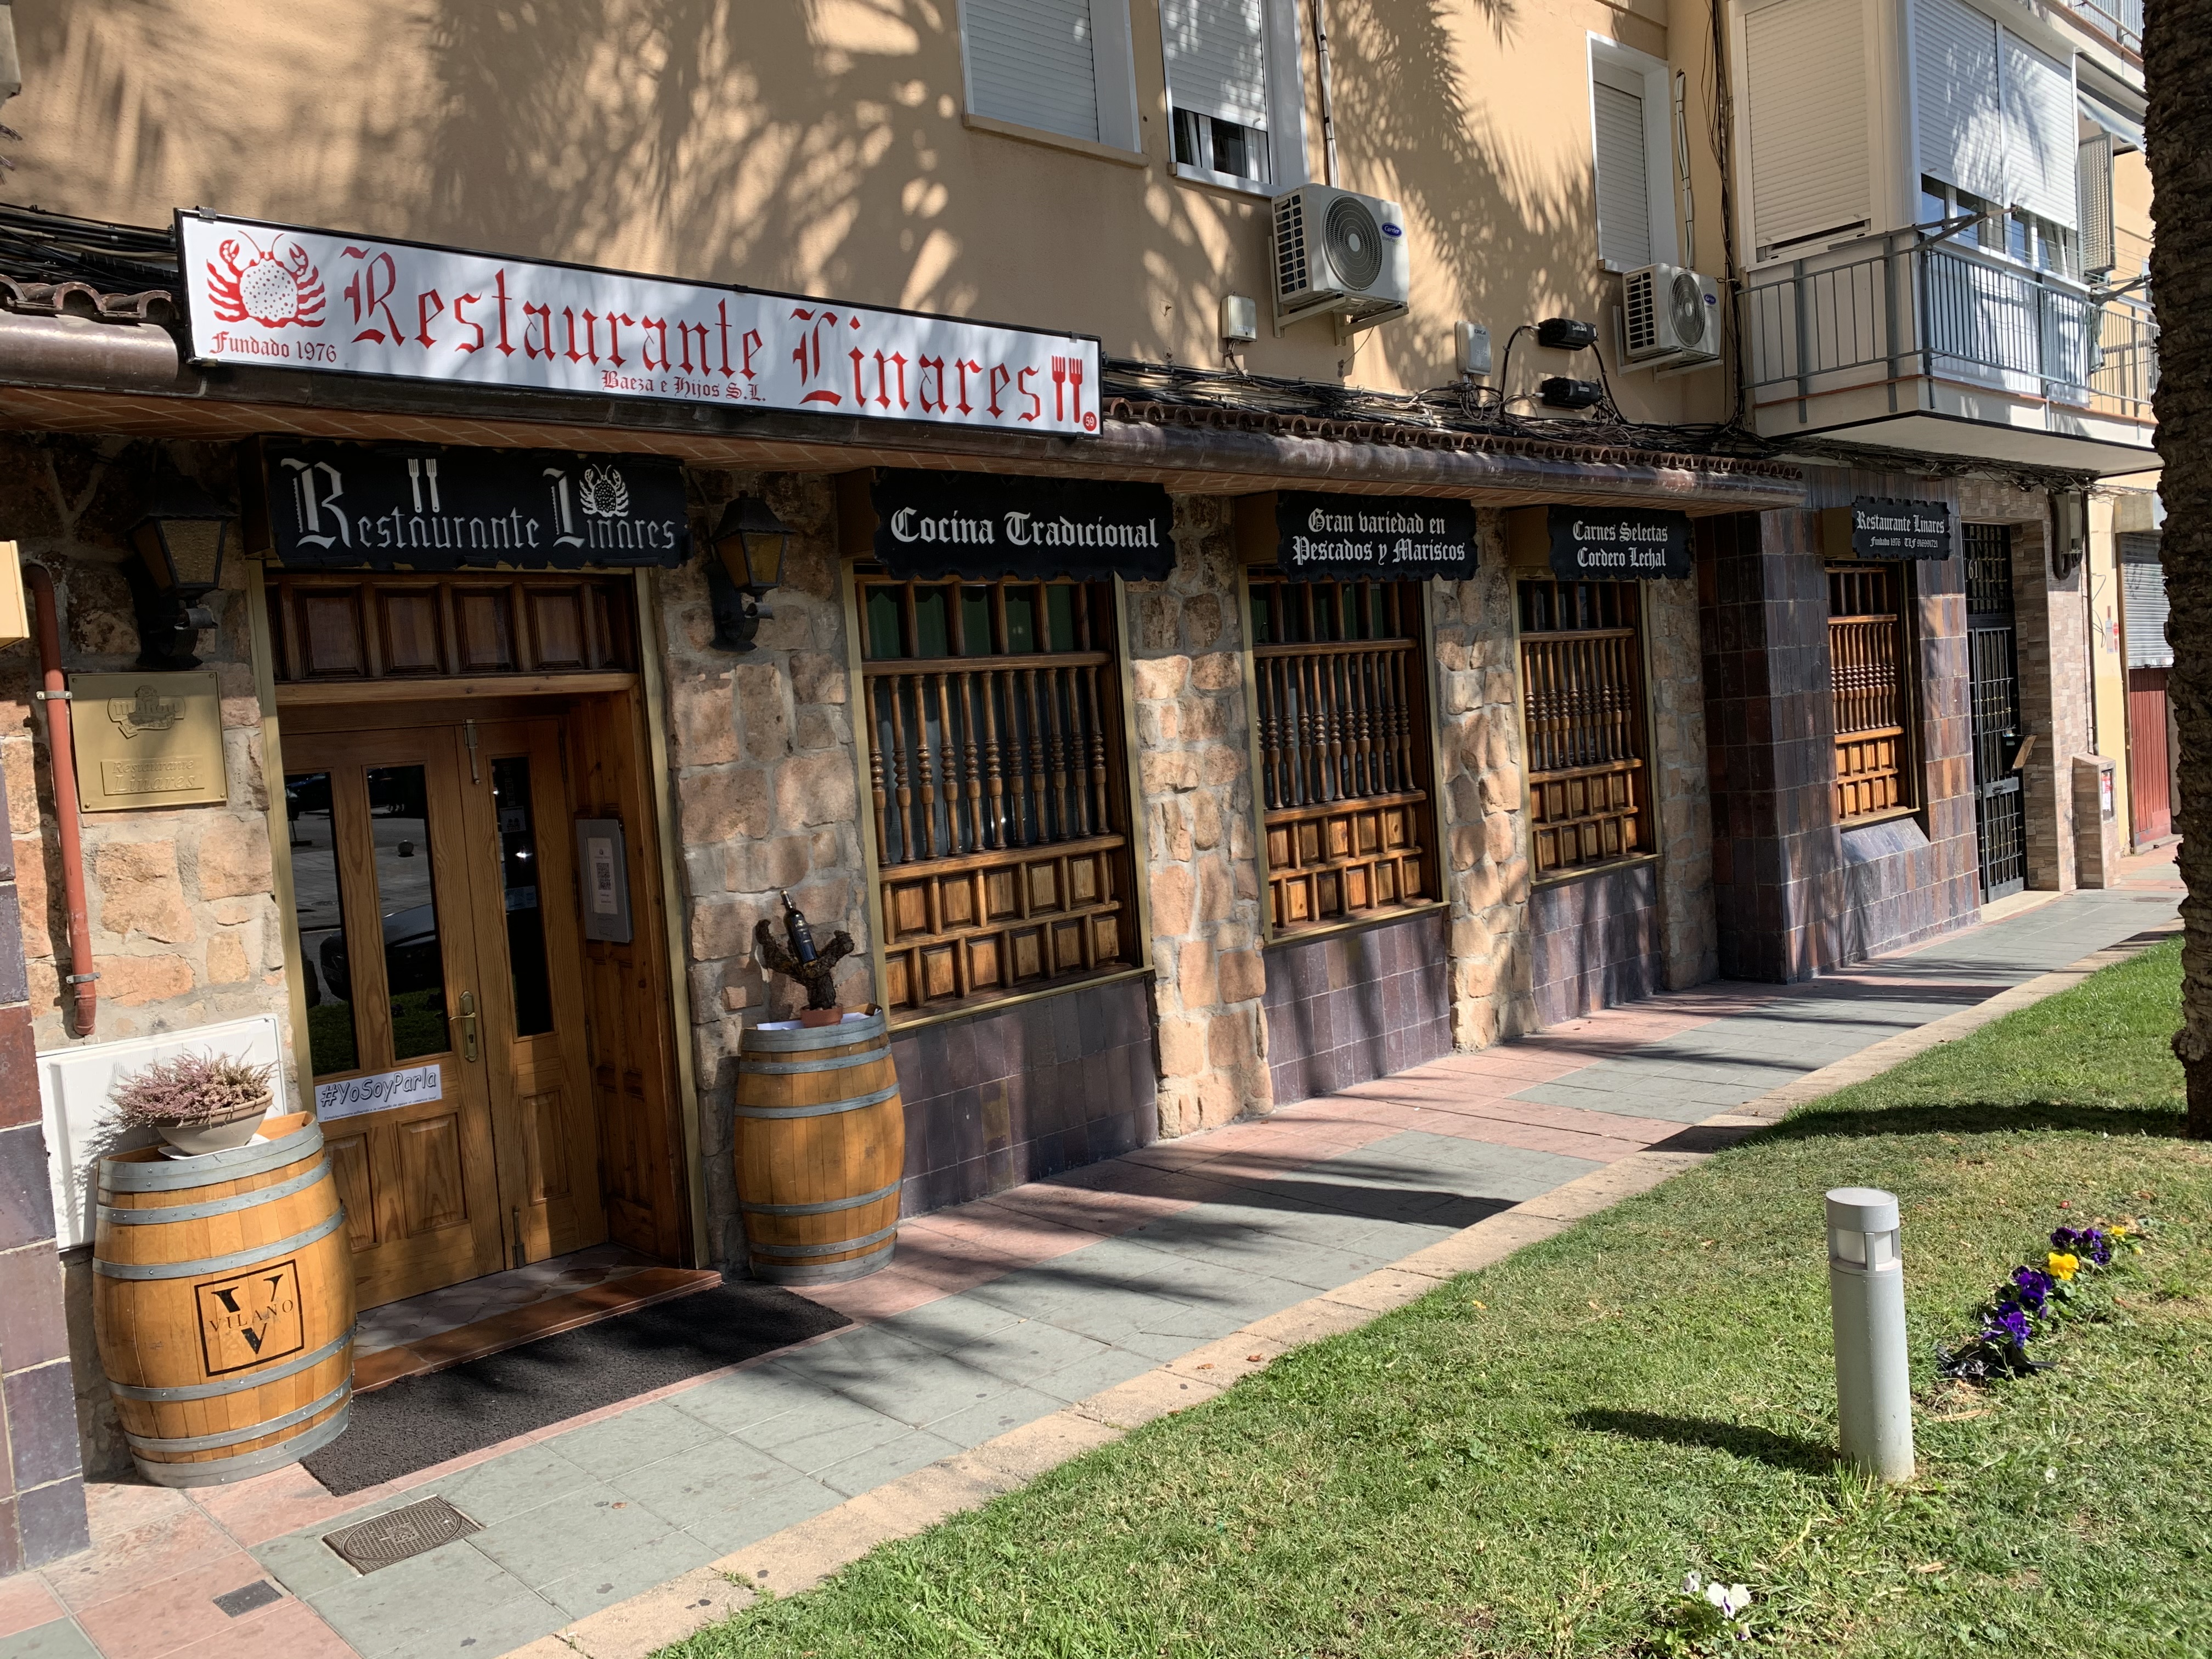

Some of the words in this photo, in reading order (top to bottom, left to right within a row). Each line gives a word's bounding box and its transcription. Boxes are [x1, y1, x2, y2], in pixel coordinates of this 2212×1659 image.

[1384, 225, 1400, 234] Carrier
[209, 331, 290, 359] Fundado
[297, 340, 337, 364] 1976
[340, 246, 763, 382] Restaurante
[789, 308, 1041, 424] Linares
[601, 370, 654, 394] Baeza
[660, 381, 669, 393] e
[674, 376, 720, 401] Hijos
[726, 382, 766, 402] S.L.
[1085, 416, 1096, 428] 59
[280, 458, 541, 549] Restaurante
[543, 467, 675, 549] Linares
[891, 506, 996, 545] Cocina
[1003, 511, 1160, 549] Tradicional
[1308, 507, 1354, 533] Gran
[1358, 509, 1425, 535] variedad
[1429, 516, 1446, 535] en
[1572, 520, 1616, 542] Carnes
[1618, 521, 1668, 543] Selectas
[1856, 510, 1911, 533] Restaurante
[1913, 514, 1945, 534] Linares
[1291, 535, 1373, 566] Pescados
[1378, 543, 1387, 566] y
[1392, 538, 1466, 563] Mariscos
[1870, 536, 1890, 547] Fundado
[1891, 538, 1901, 548] 1976
[1577, 546, 1626, 568] Cordero
[1629, 546, 1667, 570] Lechal
[1968, 559, 1978, 579] 61
[112, 760, 194, 774] Restaurante
[112, 774, 197, 793] Linares
[320, 1067, 437, 1108] #YoSoyParla
[210, 1299, 294, 1333] VILANO
